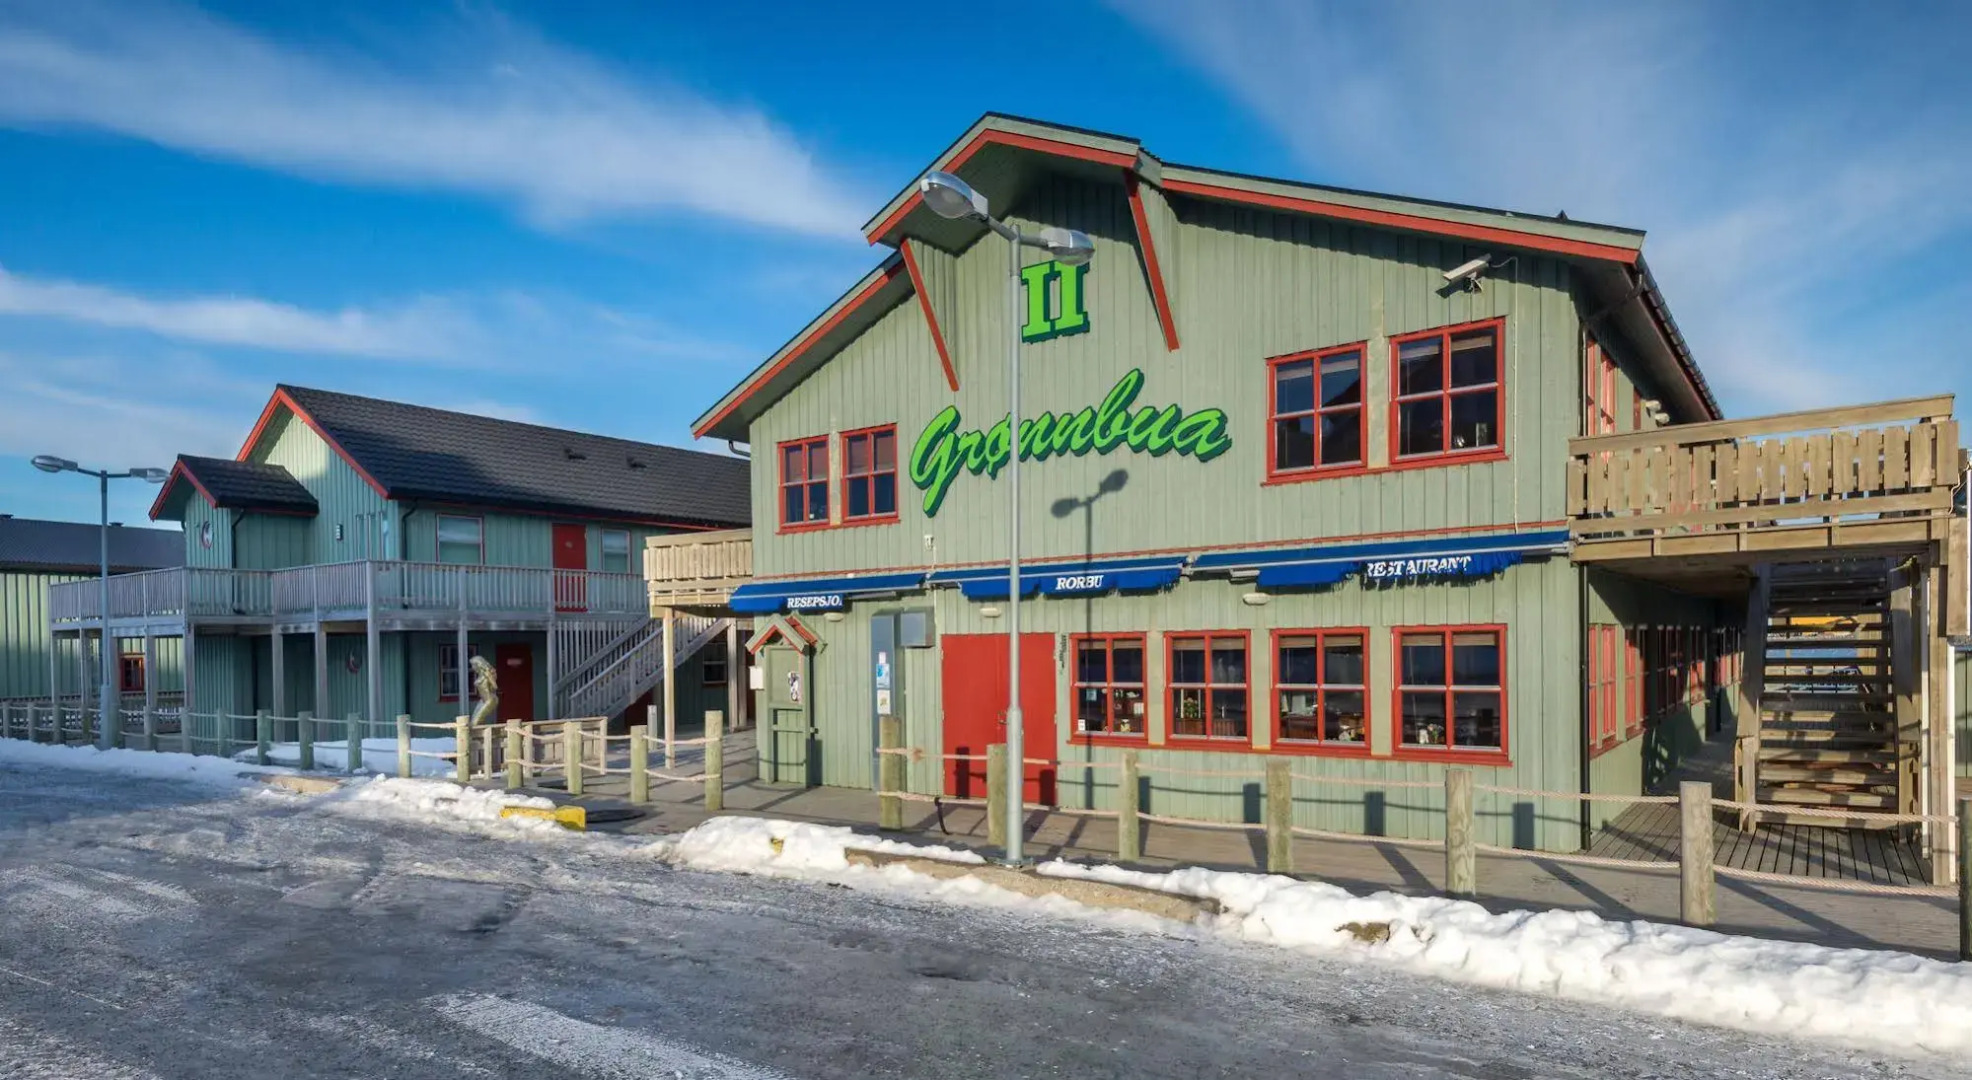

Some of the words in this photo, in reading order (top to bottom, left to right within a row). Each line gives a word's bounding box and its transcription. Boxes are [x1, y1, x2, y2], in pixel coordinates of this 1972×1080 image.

[909, 368, 1232, 518] Grønnbua
[1367, 556, 1471, 577] RESTAURANT
[1055, 575, 1104, 590] RORBU
[787, 595, 843, 608] RESEPSJO
